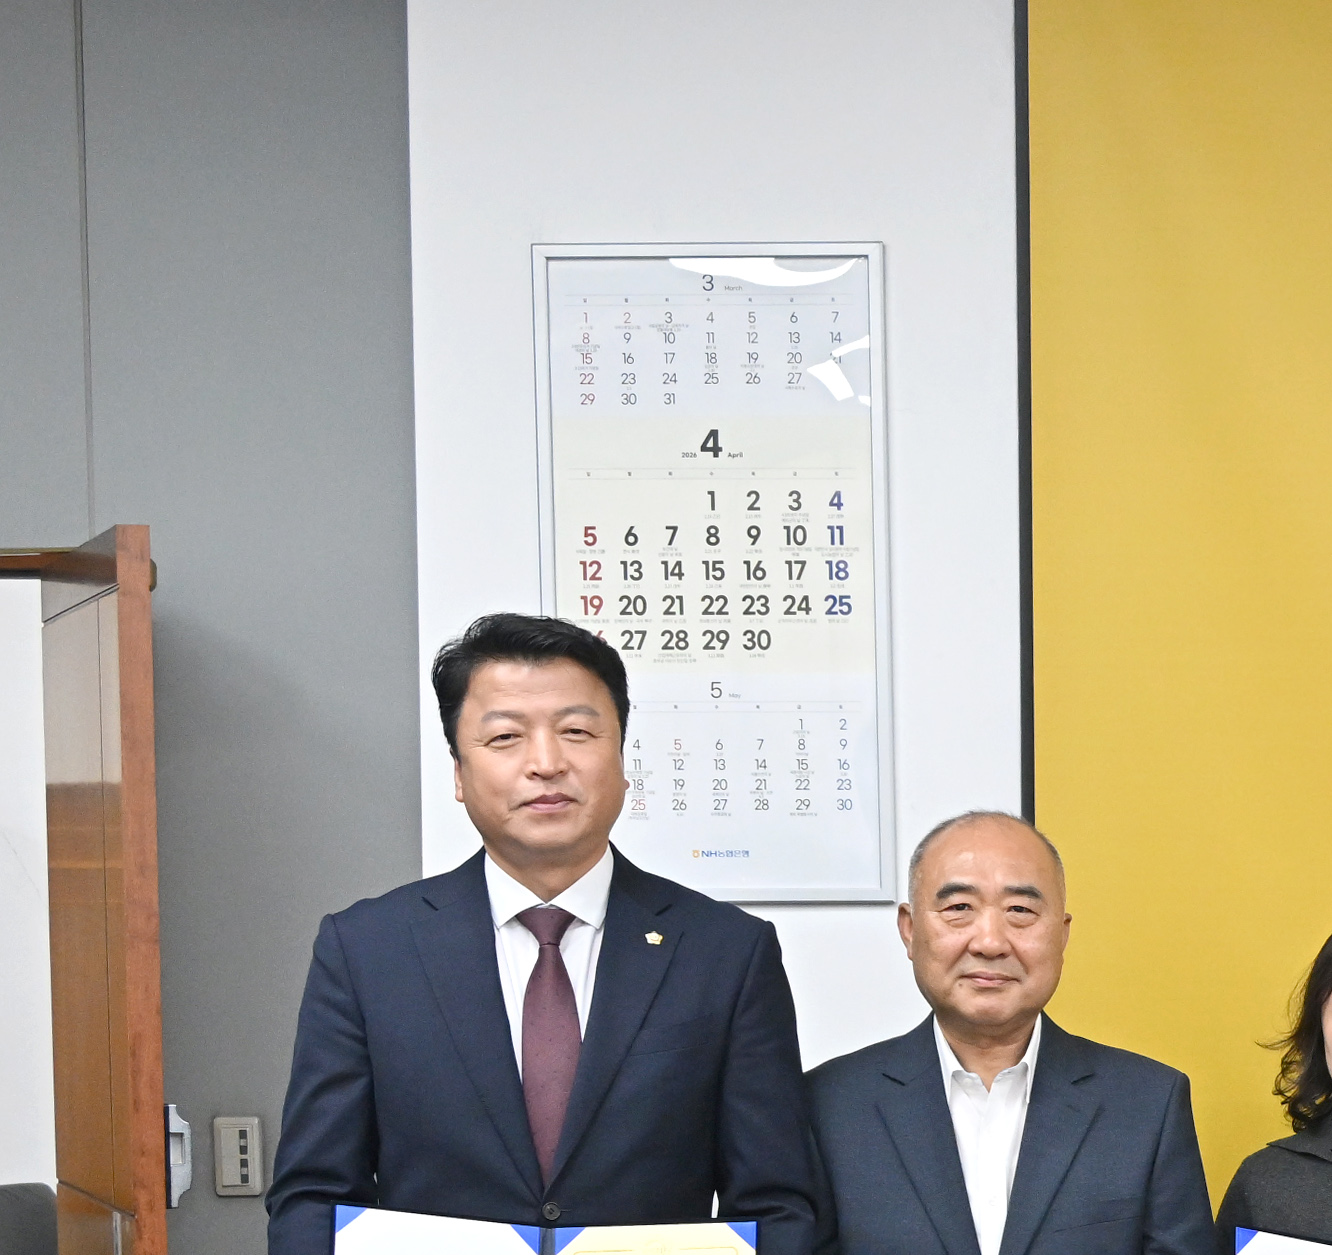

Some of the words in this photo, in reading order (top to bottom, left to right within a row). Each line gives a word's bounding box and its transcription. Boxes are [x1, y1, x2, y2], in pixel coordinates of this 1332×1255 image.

[701, 274, 715, 292] 3
[724, 284, 743, 292] March
[623, 311, 632, 324] 2
[664, 311, 673, 324] 3
[705, 311, 715, 324] 4
[747, 311, 757, 324] 5
[789, 311, 799, 324] 6
[831, 310, 840, 323] 7
[582, 332, 591, 345] 8
[623, 331, 632, 344] 9
[662, 331, 676, 345] 10
[705, 331, 715, 344] 11
[746, 331, 759, 344] 12
[788, 331, 801, 344] 13
[829, 331, 842, 344] 14
[580, 352, 593, 365] 15
[621, 352, 635, 365] 16
[663, 352, 676, 365] 17
[704, 351, 718, 365] 18
[746, 351, 759, 364] 19
[786, 351, 803, 365] 20
[579, 372, 595, 385] 22
[620, 372, 637, 385] 23
[662, 372, 678, 385] 24
[703, 372, 720, 385] 25
[745, 371, 761, 385] 26
[787, 372, 803, 385] 27
[579, 392, 596, 406] 29
[620, 392, 638, 406] 30
[663, 392, 676, 406] 31
[681, 451, 698, 459] 2026
[699, 428, 723, 459] 4
[727, 451, 744, 460] April
[706, 490, 716, 512] 1
[746, 490, 761, 512] 2
[787, 489, 802, 512] 3
[828, 490, 844, 511] 4
[583, 525, 598, 547] 5
[624, 525, 639, 547] 6
[665, 525, 679, 546] 7
[705, 524, 721, 547] 8
[746, 524, 762, 546] 9
[782, 524, 808, 547] 10
[826, 525, 845, 546] 11
[578, 559, 603, 581] 12
[619, 559, 644, 582] 13
[660, 560, 685, 581] 14
[701, 560, 726, 582] 15
[742, 559, 767, 582] 16
[784, 559, 807, 581] 17
[824, 559, 850, 582] 18
[579, 594, 604, 616] 19
[618, 594, 648, 616] 20
[661, 594, 685, 616] 21
[700, 594, 730, 616] 22
[741, 594, 771, 616] 23
[782, 594, 813, 616] 24
[823, 594, 853, 616] 25
[620, 629, 648, 651] 27
[660, 629, 690, 651] 28
[701, 629, 730, 651] 29
[742, 629, 772, 651] 30
[710, 681, 723, 699] 5
[838, 718, 848, 731] 2
[632, 738, 641, 751] 4
[673, 738, 682, 751] 5
[715, 738, 724, 751] 6
[756, 738, 765, 751] 7
[797, 738, 806, 751] 8
[839, 738, 848, 751] 9
[632, 758, 642, 771] 11
[672, 758, 685, 771] 12
[713, 758, 727, 771] 13
[754, 758, 768, 770] 14
[795, 758, 809, 771] 15
[837, 758, 851, 771] 16
[631, 778, 645, 791] 18
[672, 778, 686, 791] 19
[711, 778, 728, 791] 20
[754, 778, 767, 791] 21
[794, 778, 811, 791] 22
[836, 778, 852, 791] 23
[630, 798, 646, 811] 25
[671, 798, 688, 811] 26
[712, 798, 728, 811] 27
[754, 798, 770, 811] 28
[795, 798, 811, 811] 29
[836, 798, 853, 811] 30
